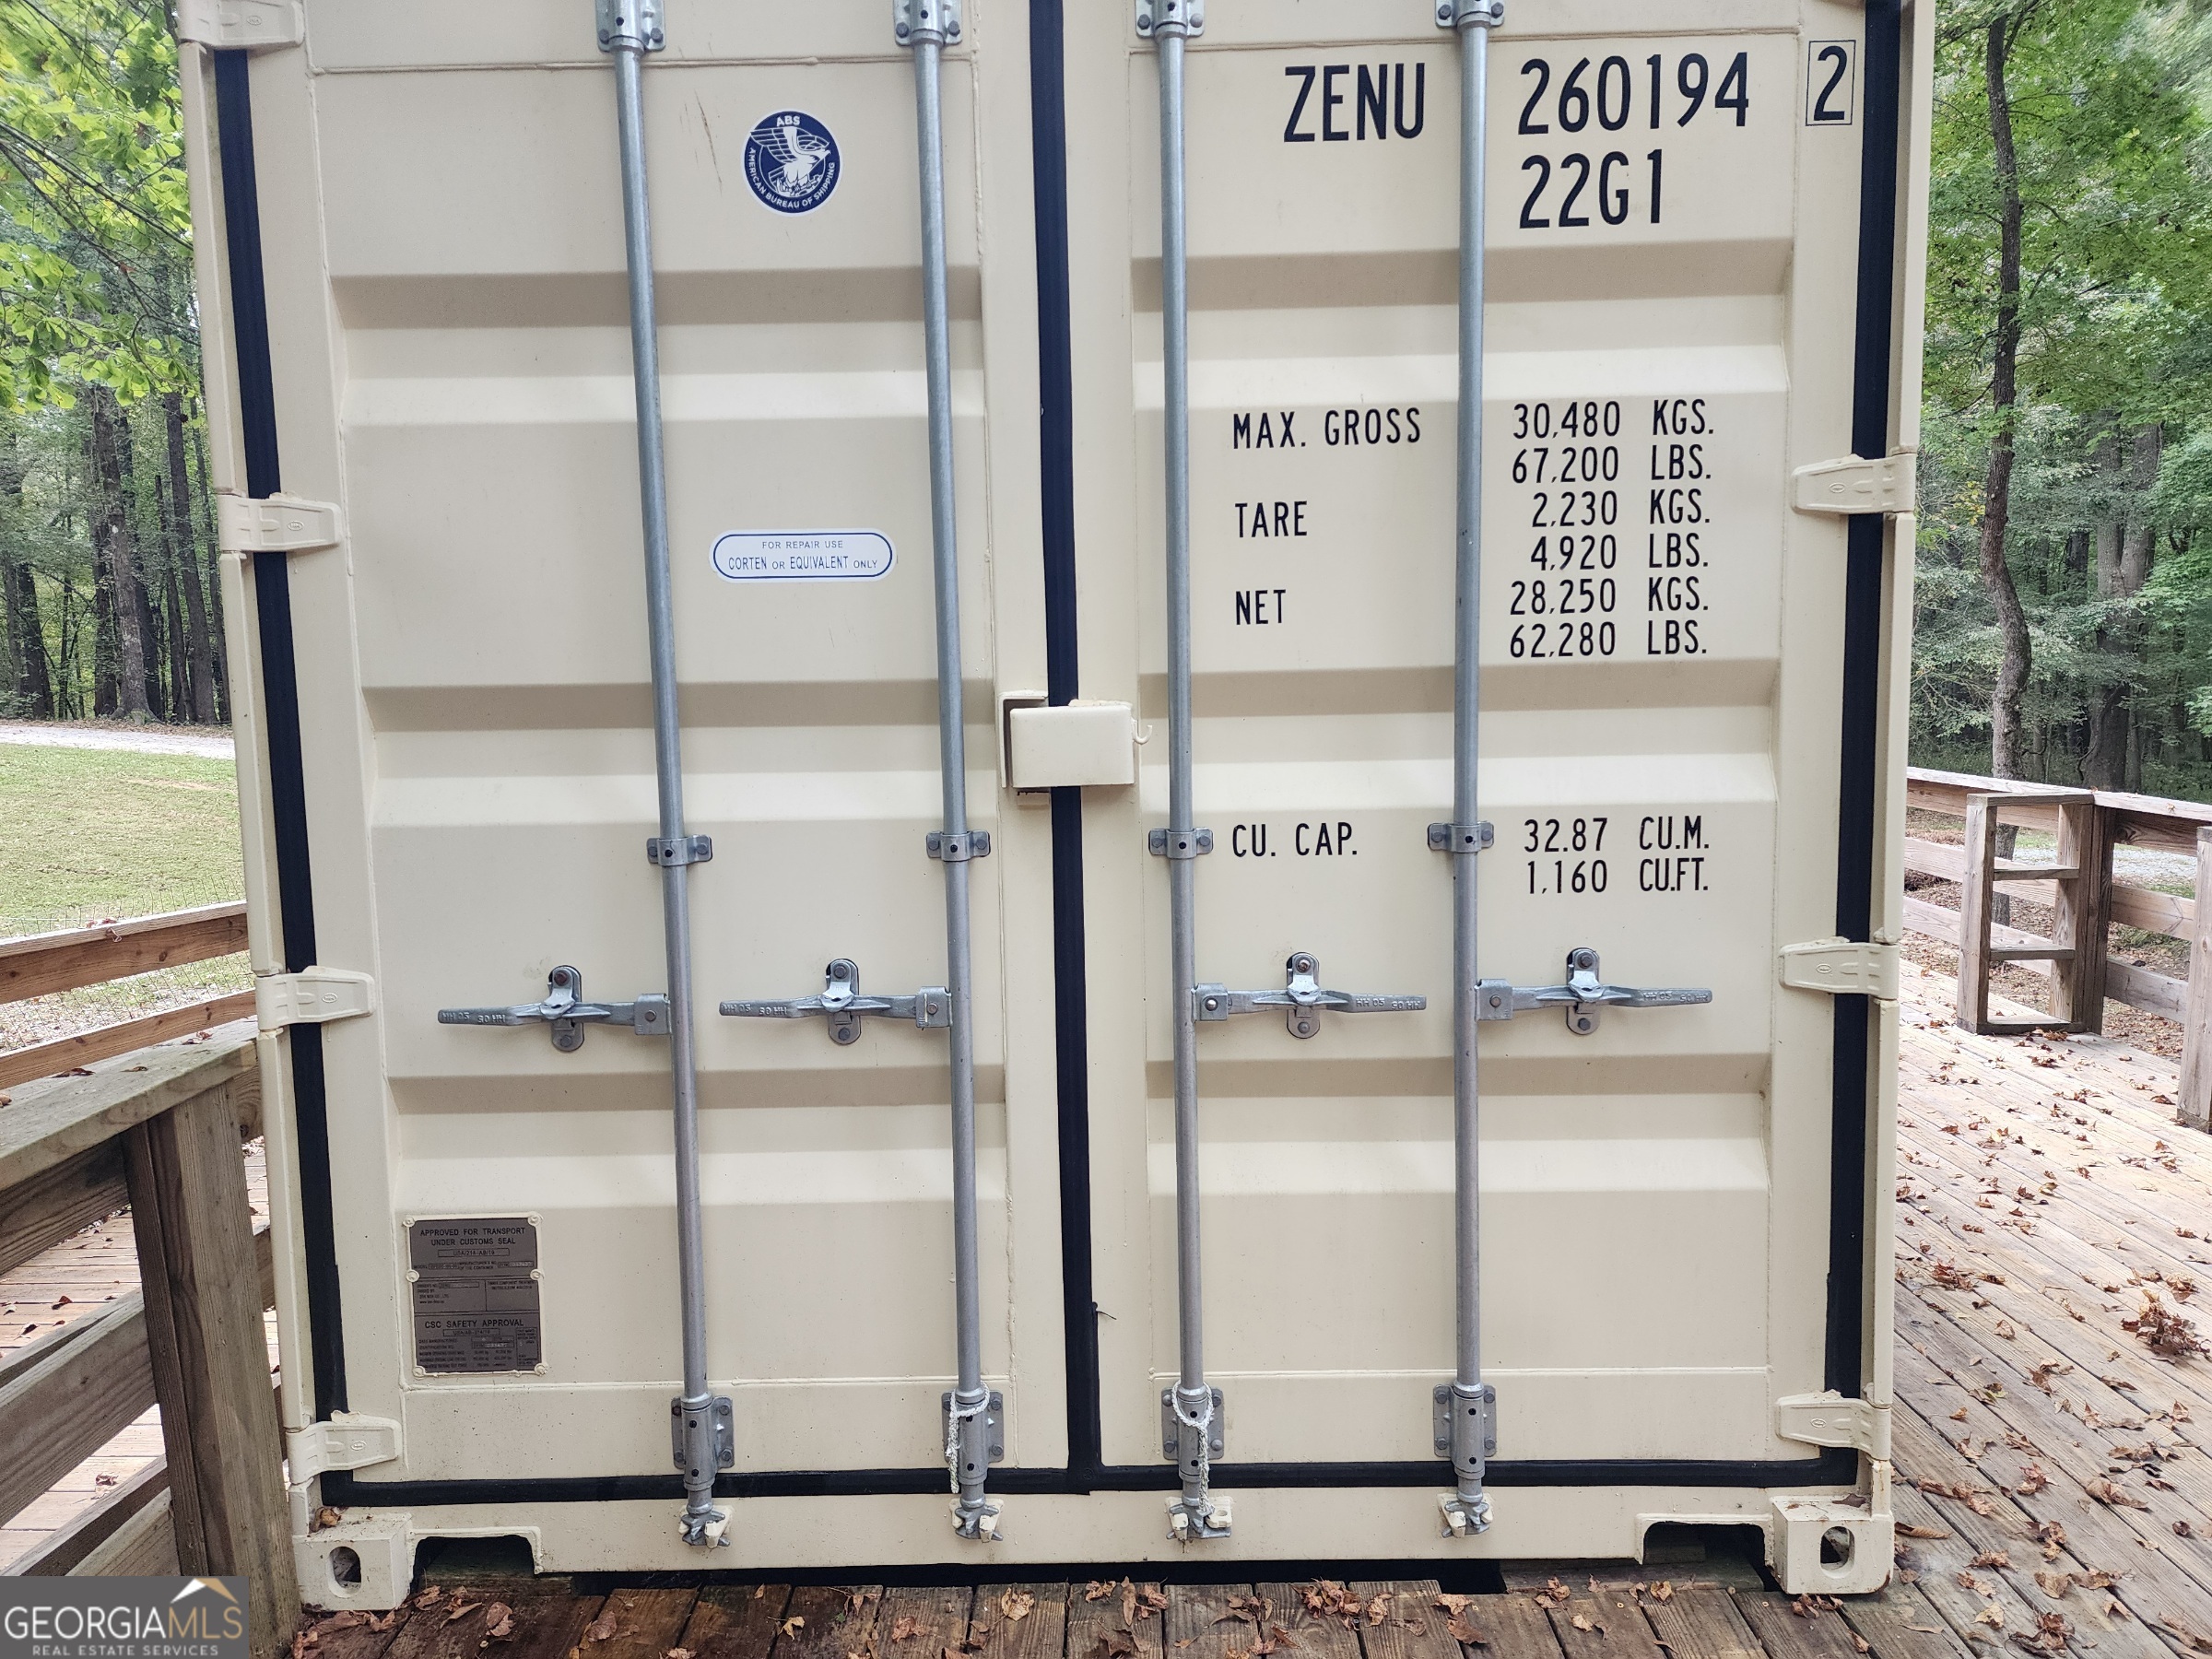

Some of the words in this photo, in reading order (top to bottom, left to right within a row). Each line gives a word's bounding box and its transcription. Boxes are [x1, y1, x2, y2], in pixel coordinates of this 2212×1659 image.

[1284, 63, 1424, 142] ZENU
[1519, 52, 1749, 135] 260194
[1813, 46, 1847, 122] 2
[776, 115, 801, 126] ABS
[747, 147, 767, 194] AMERICAN
[765, 193, 800, 208] BUREAU
[801, 197, 813, 206] OF
[814, 161, 836, 201] SHIPPING
[1520, 149, 1662, 229] 22G1
[1233, 411, 1306, 450] MAX.
[1324, 407, 1420, 445] GROSS
[1513, 400, 1620, 440] 30,480
[1653, 398, 1714, 436] KGS.
[1512, 445, 1619, 484] 67,200
[1651, 443, 1712, 481] LBS.
[1235, 500, 1308, 538] TARE
[1532, 490, 1618, 528] 2,230
[1650, 488, 1711, 524] KGS.
[728, 556, 767, 571] CORTEN
[771, 560, 785, 570] OR
[790, 555, 849, 570] EQUIVALENT
[853, 559, 877, 569] ONLY
[761, 541, 782, 549] FOR
[785, 540, 820, 549] REPAIR
[825, 540, 843, 548] USE
[1530, 534, 1617, 571] 4,920
[1648, 532, 1709, 569] LBS.
[1235, 589, 1287, 626] NET
[1510, 578, 1616, 616] 28,250
[1648, 575, 1709, 612] KGS.
[1510, 621, 1616, 658] 62,280
[1646, 619, 1707, 655] LBS.
[1231, 823, 1276, 858] CU.
[1295, 821, 1358, 856] CAP.
[1524, 818, 1609, 853] 32.87
[1639, 815, 1710, 851] CU.M.
[1527, 859, 1607, 894] 1,160
[1640, 857, 1709, 892] CU.FT.
[483, 1227, 526, 1235] TRANSPORT
[425, 1321, 441, 1329] CSC
[446, 1320, 477, 1328] SAFETY
[482, 1319, 524, 1327] APPROVAL
